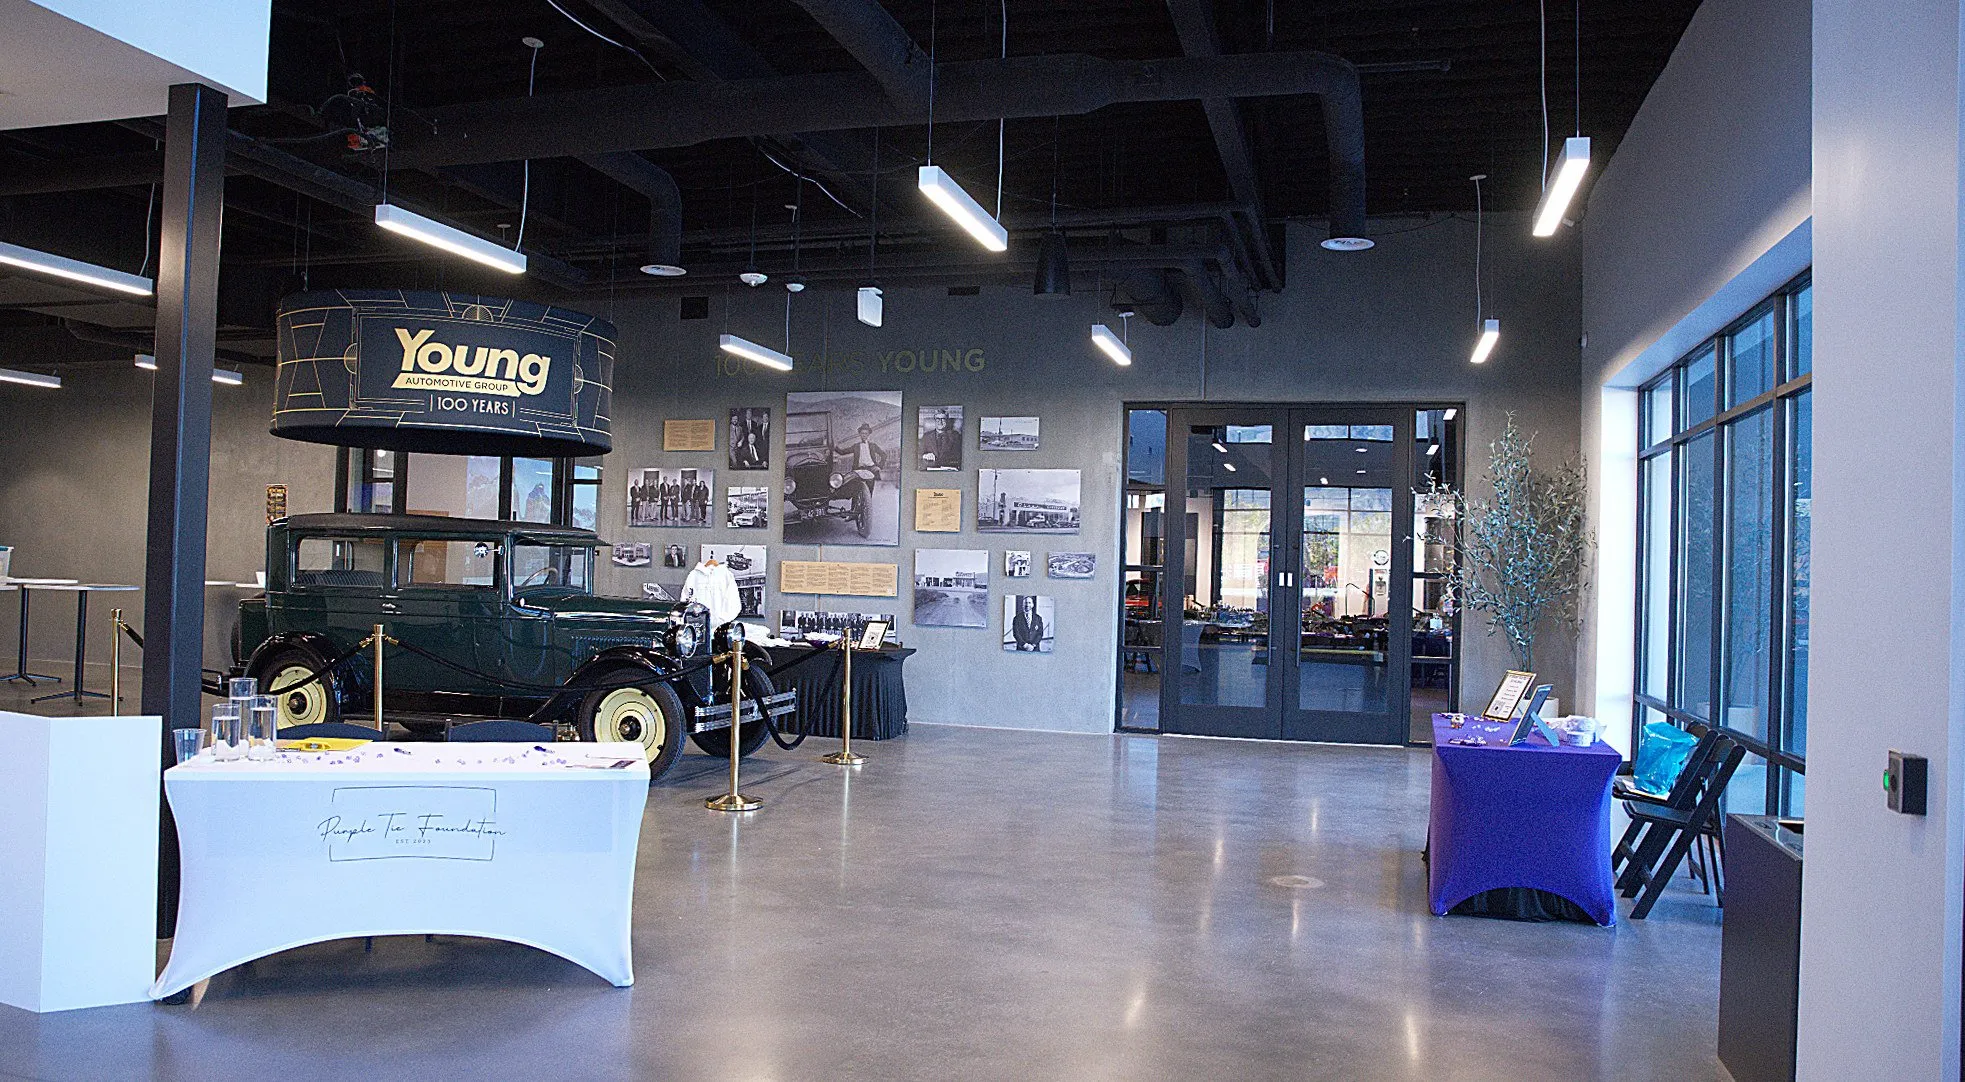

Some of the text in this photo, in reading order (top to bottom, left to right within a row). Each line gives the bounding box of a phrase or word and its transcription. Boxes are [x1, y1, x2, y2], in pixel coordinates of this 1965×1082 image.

[395, 328, 552, 396] Young
[877, 349, 985, 373] YOUNG
[406, 376, 509, 392] AUTOMOTIVE GROUP
[438, 396, 509, 415] 100 YEARS
[317, 812, 508, 844] Purple Tie Foundation
